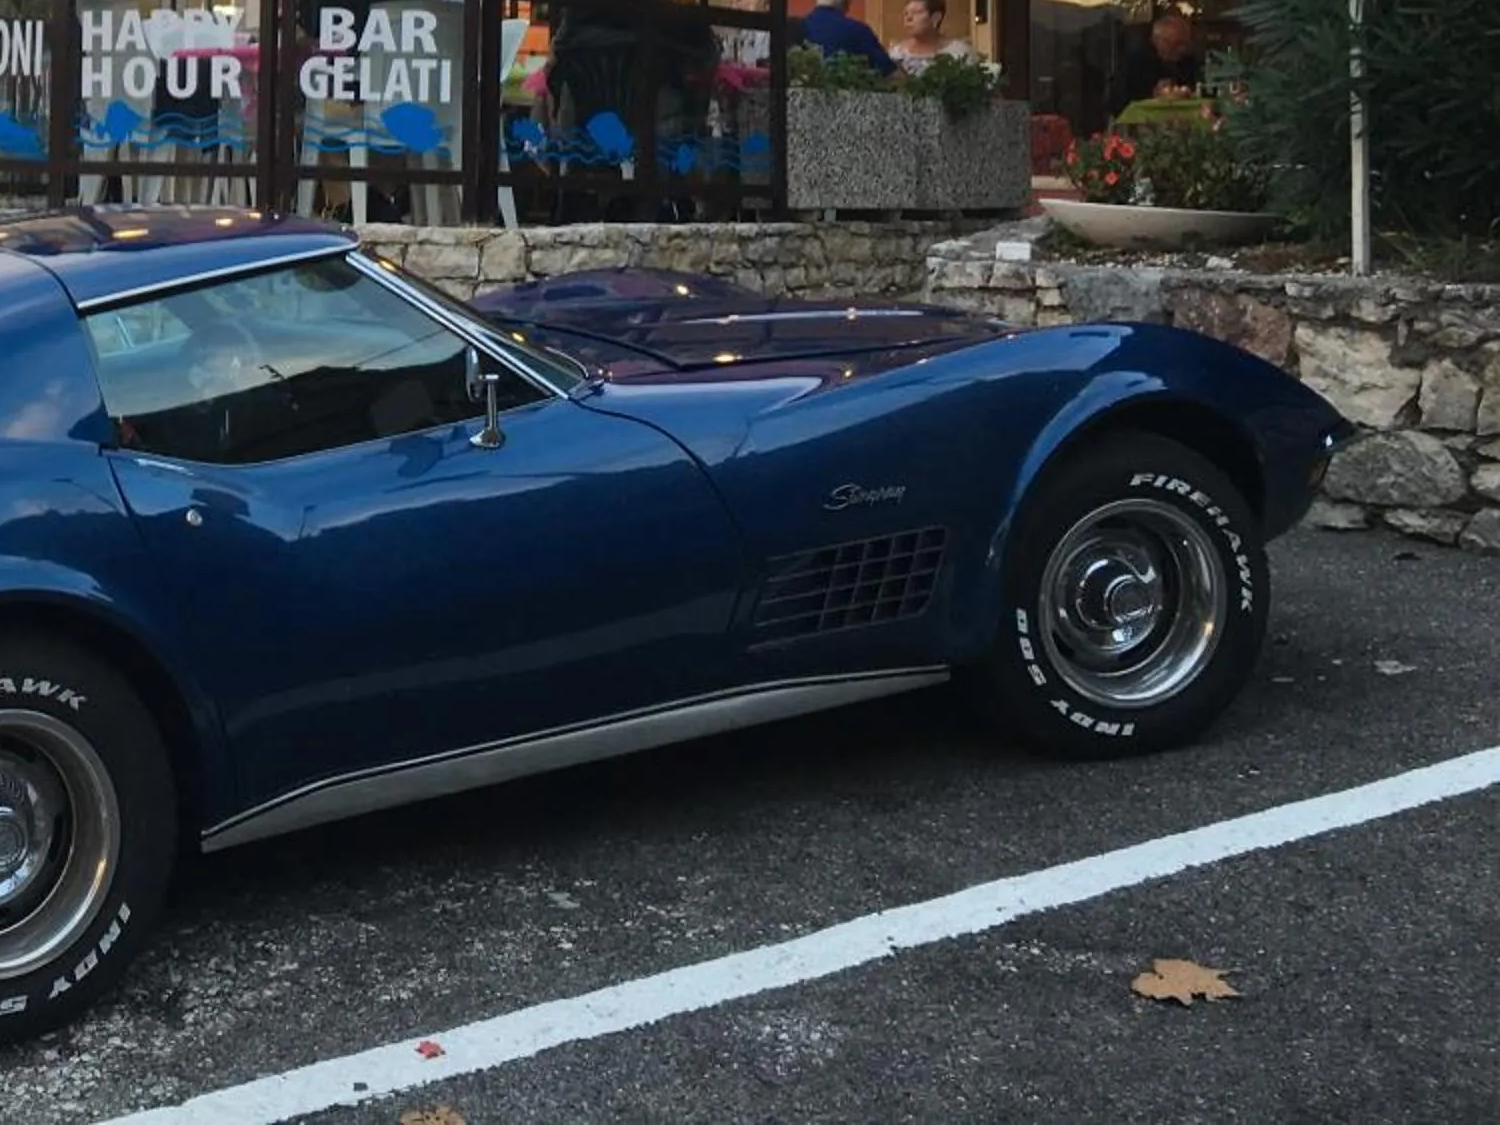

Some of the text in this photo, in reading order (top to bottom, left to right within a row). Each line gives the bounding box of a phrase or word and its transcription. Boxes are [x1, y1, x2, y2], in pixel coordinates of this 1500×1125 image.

[81, 8, 245, 52] HAPPY
[319, 7, 438, 53] BAR
[81, 56, 242, 99] HOUR
[300, 58, 452, 104] GELATI
[1016, 607, 1047, 686] 500
[48, 903, 131, 999] INDY
